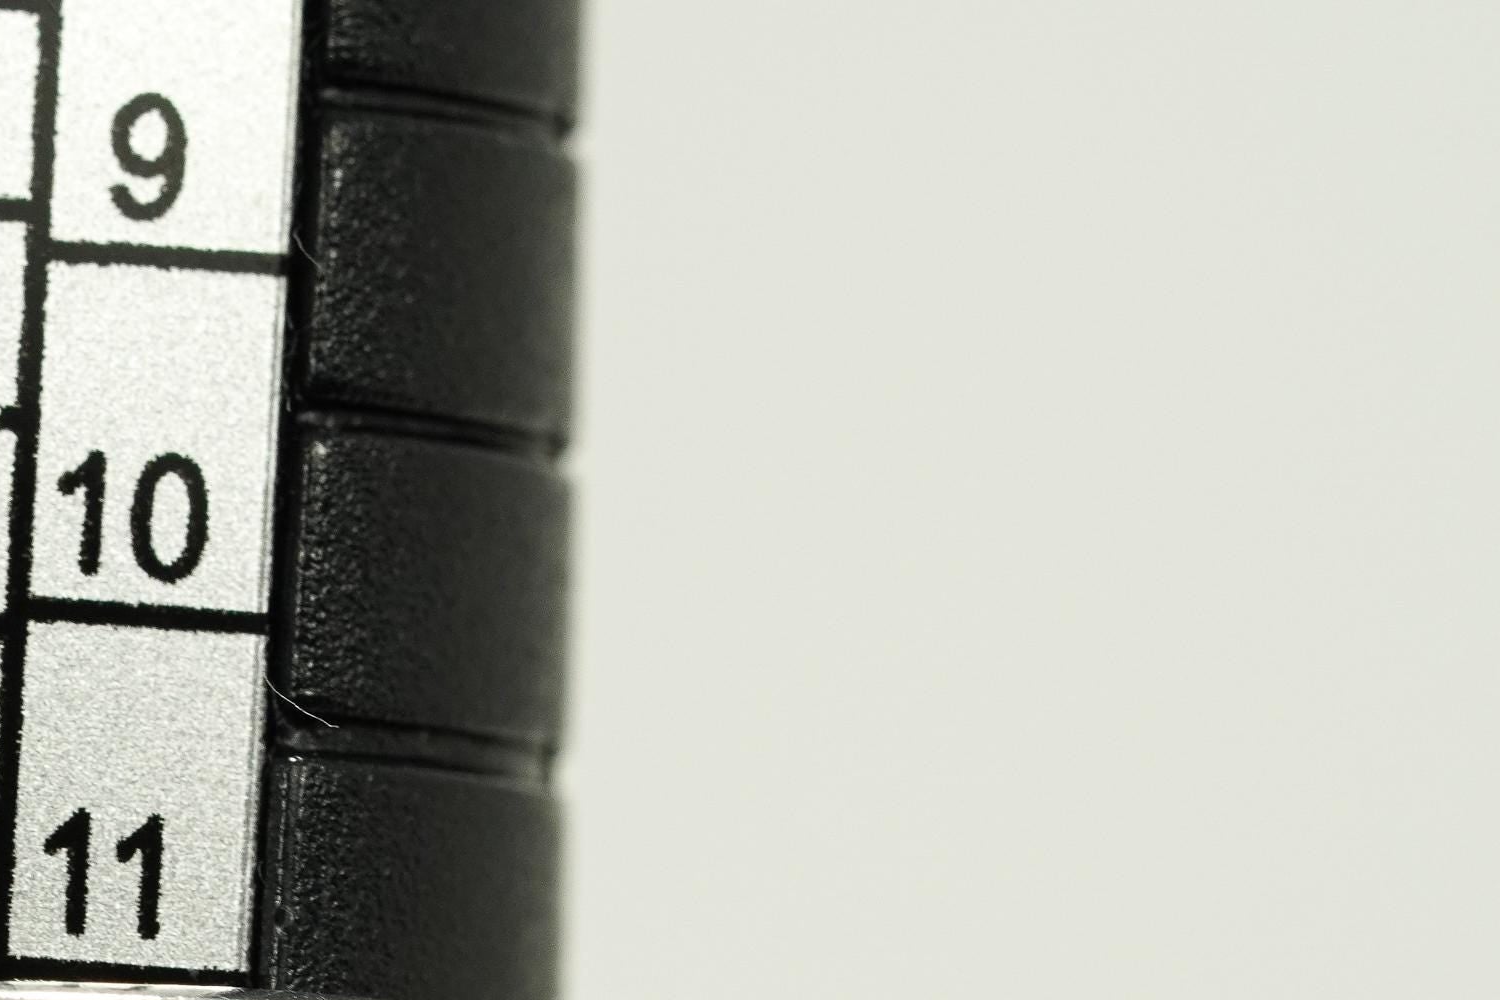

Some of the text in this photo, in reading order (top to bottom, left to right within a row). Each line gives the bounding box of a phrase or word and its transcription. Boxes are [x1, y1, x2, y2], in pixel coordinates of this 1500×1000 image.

[110, 92, 188, 221] 9
[57, 450, 210, 585] 10
[42, 807, 166, 941] 11
